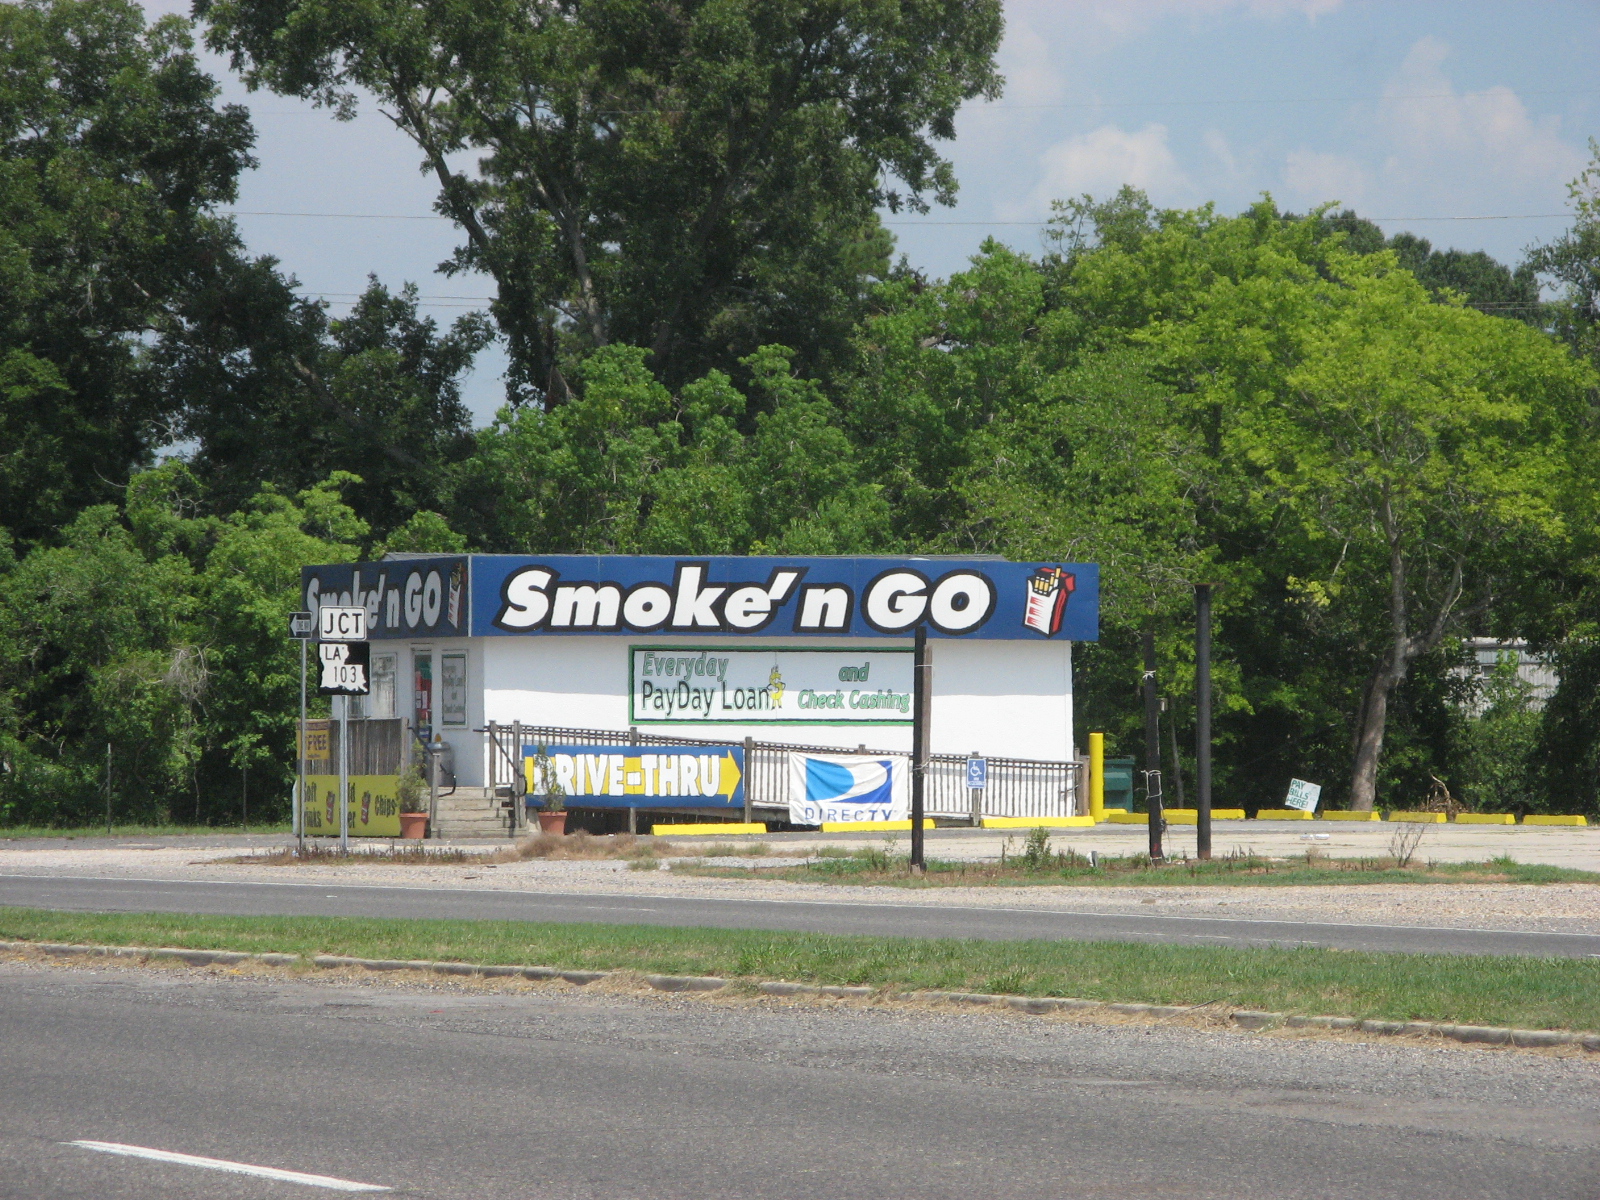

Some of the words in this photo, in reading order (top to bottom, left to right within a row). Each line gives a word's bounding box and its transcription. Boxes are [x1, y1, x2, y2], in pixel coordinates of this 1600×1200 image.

[404, 570, 442, 629] GO
[867, 572, 991, 630] GO
[324, 612, 363, 634] JCT
[325, 646, 341, 660] LA
[334, 665, 357, 683] 103
[642, 652, 729, 682] Everyday
[838, 662, 870, 682] and
[641, 680, 715, 718] PayDay
[798, 689, 845, 710] Check
[849, 690, 911, 713] Cashing
[307, 734, 327, 751] FREE
[1289, 788, 1309, 800] BILLS
[1291, 780, 1306, 789] PAY
[374, 794, 397, 818] Chips
[1286, 796, 1309, 809] HERE!
[804, 807, 893, 822] DIRECTV
